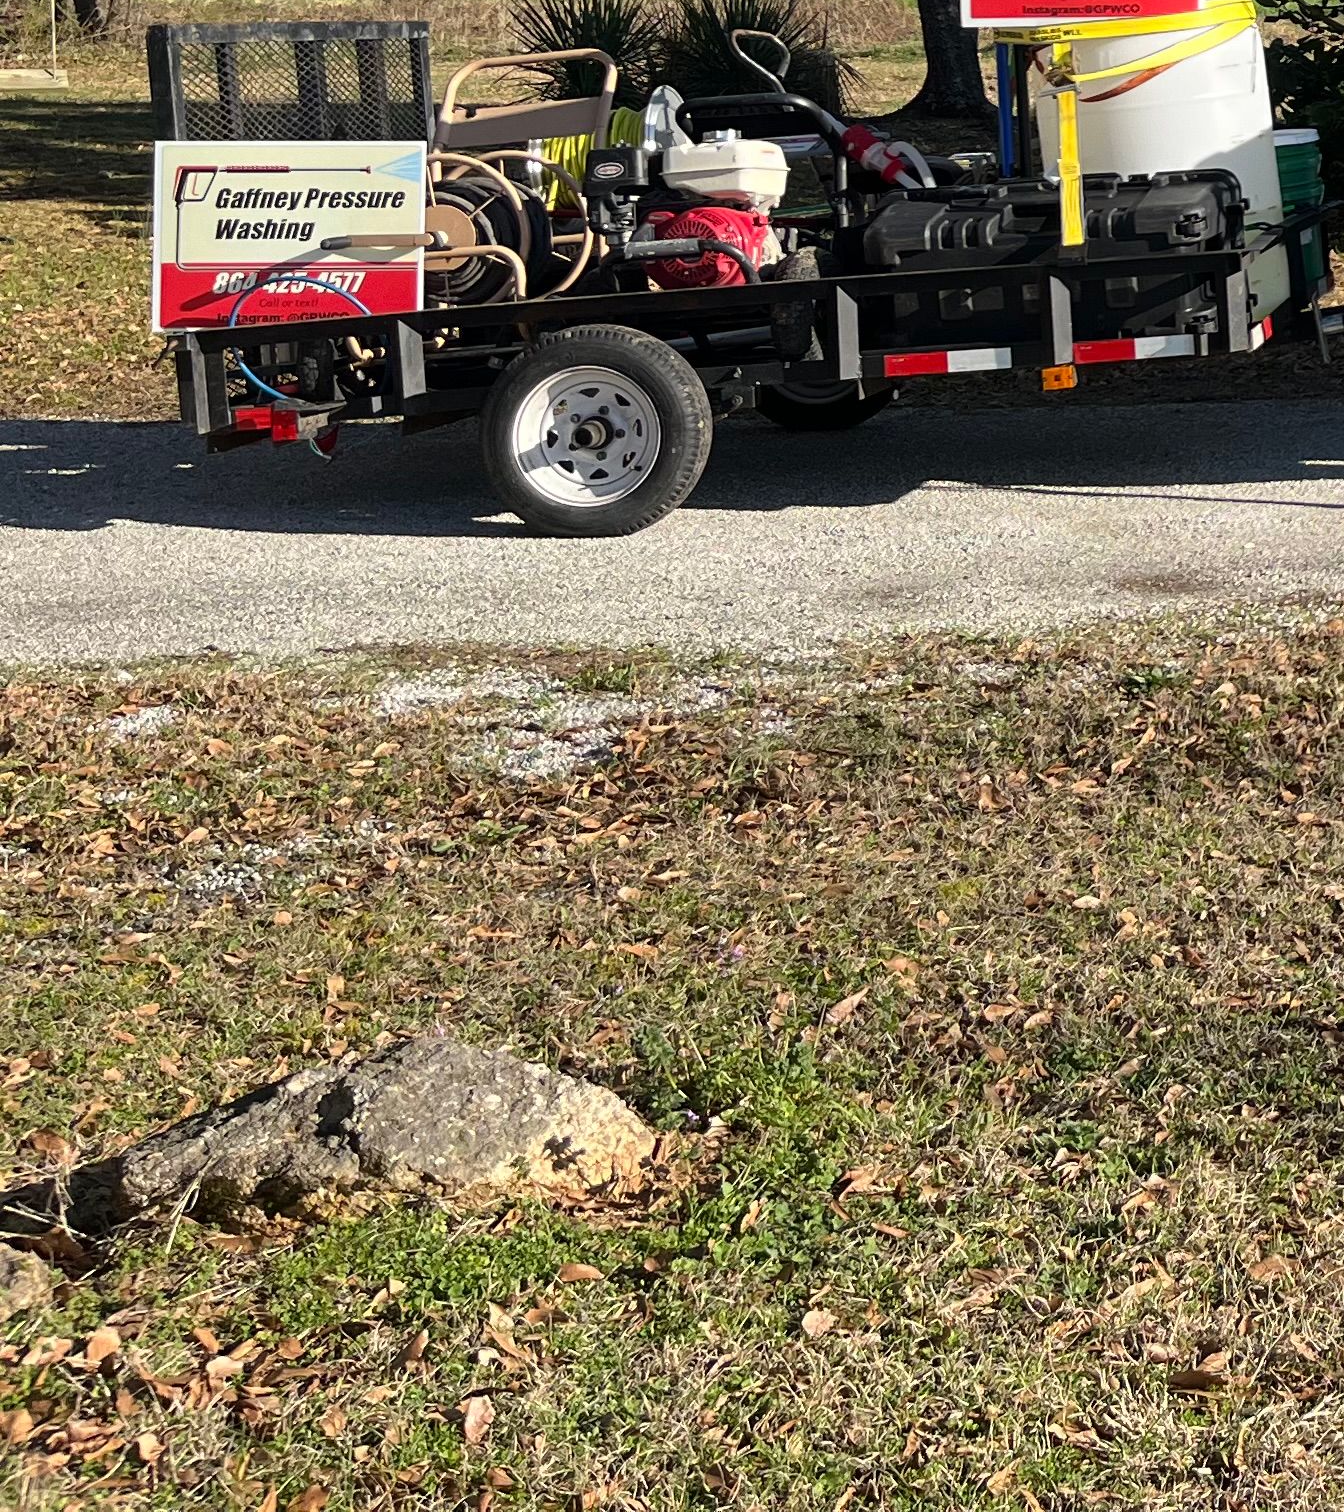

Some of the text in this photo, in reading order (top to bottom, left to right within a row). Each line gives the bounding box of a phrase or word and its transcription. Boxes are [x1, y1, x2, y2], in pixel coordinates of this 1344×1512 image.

[215, 188, 405, 210] Gaffney Pressure
[215, 218, 315, 242] Washing
[259, 299, 280, 308] Call
[217, 313, 284, 325] Intagram:
